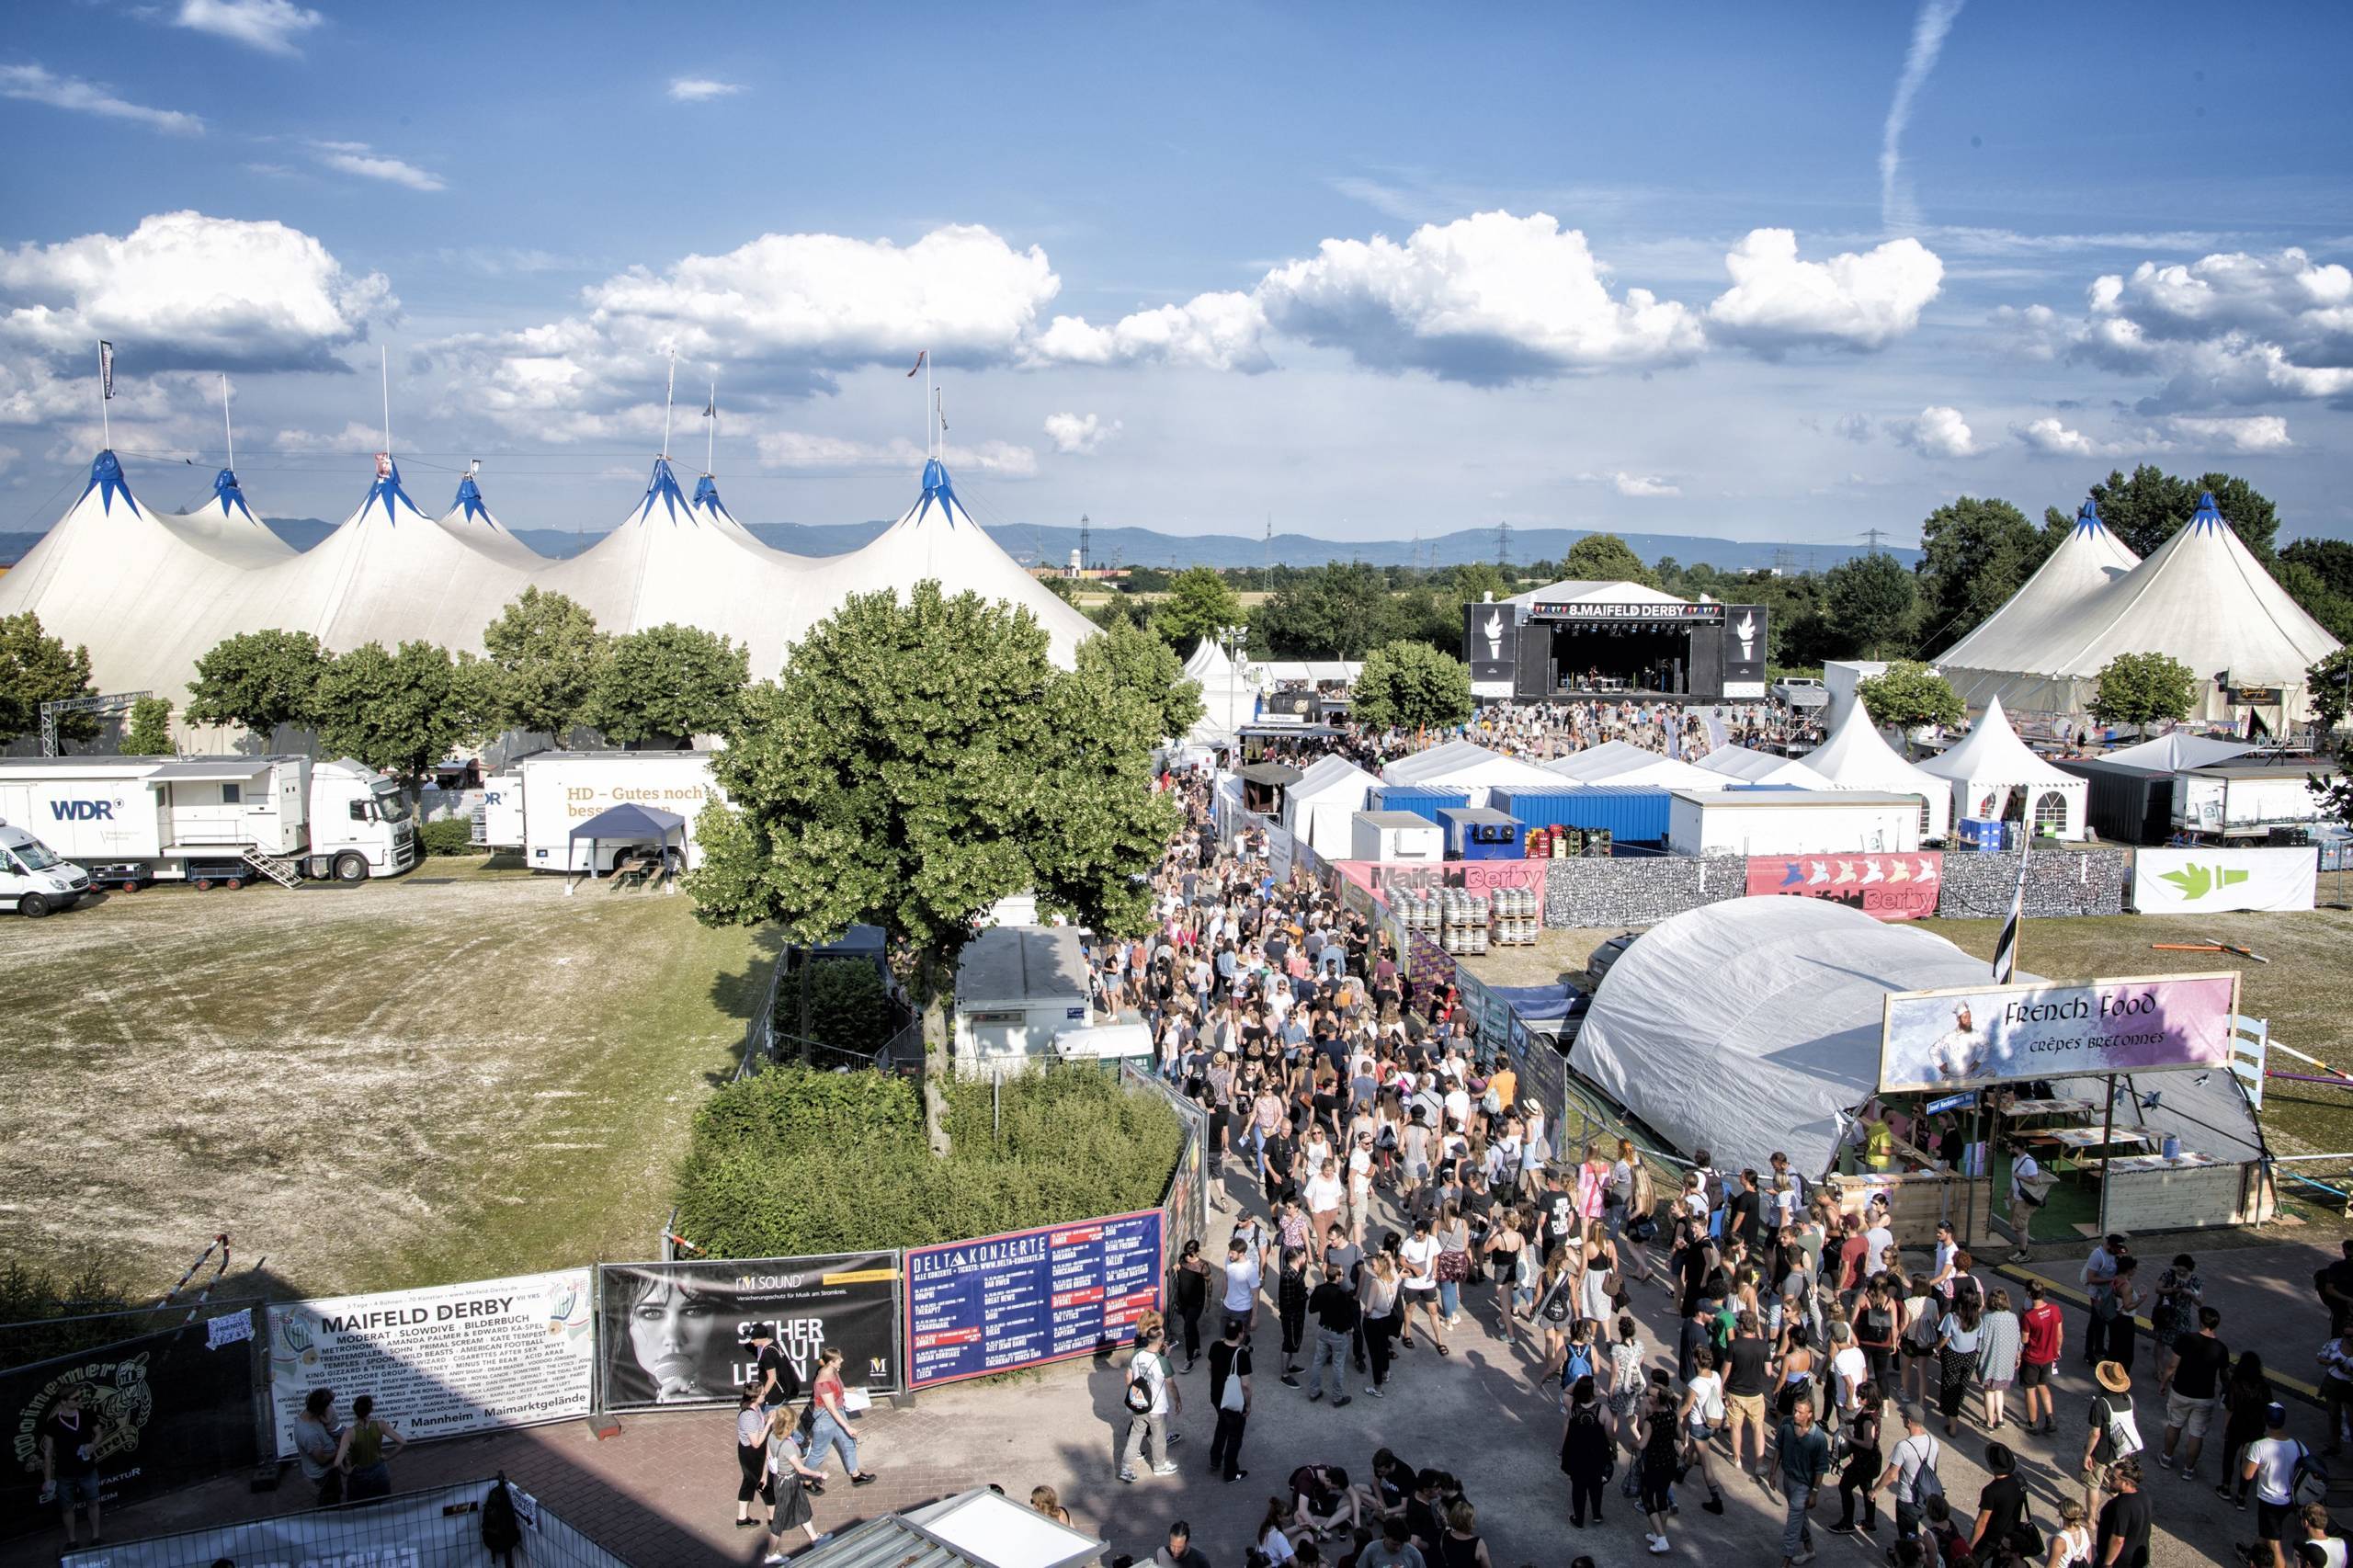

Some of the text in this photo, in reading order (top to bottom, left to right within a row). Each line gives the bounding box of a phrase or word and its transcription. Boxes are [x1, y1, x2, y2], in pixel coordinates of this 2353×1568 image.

[1569, 604, 1686, 618] 8.MAIFELD DERBY
[567, 786, 702, 801] HD Gutes noch
[51, 800, 114, 821] WDR
[969, 1236, 1045, 1264] KONZERTE
[914, 1272, 926, 1281] ALLE
[927, 1267, 951, 1279] KONZERTE
[736, 1292, 785, 1301] Versicherungsschutz
[321, 1296, 514, 1335] MAIFELD DERBY
[336, 1313, 529, 1345] MODERAT SLOWDIVE BILDERBUCH
[320, 1329, 546, 1363] TRENTEMØLLER SOHN PRIMAL SCREAM KATE TEMPEST
[321, 1341, 378, 1355] METRONOMY
[386, 1335, 425, 1346] AMANDA
[426, 1331, 460, 1342] PALMER
[472, 1325, 508, 1336] EDWARD
[510, 1322, 544, 1332] KA-SPEL
[323, 1336, 544, 1369] TEMPLES SPOON WILD BEASTS AMERICAN FOOTBALL
[307, 1376, 347, 1386] THURSTON
[350, 1372, 378, 1381] MOORE
[381, 1369, 407, 1378] GROUP
[414, 1363, 449, 1374] WHITNEY
[455, 1360, 480, 1369] MINUS
[498, 1356, 517, 1364] BEAR
[328, 1367, 360, 1376] GIZZARD
[370, 1363, 385, 1371] THE
[387, 1360, 414, 1369] LIZARD
[416, 1357, 446, 1366] WIZARD
[452, 1350, 497, 1361] CIGARETTES
[499, 1347, 522, 1357] AFTER
[543, 1341, 564, 1349] WHY?
[733, 1359, 806, 1386] LEN
[411, 1410, 472, 1427] Mannheim
[483, 1392, 585, 1418] Maimarktgelände
